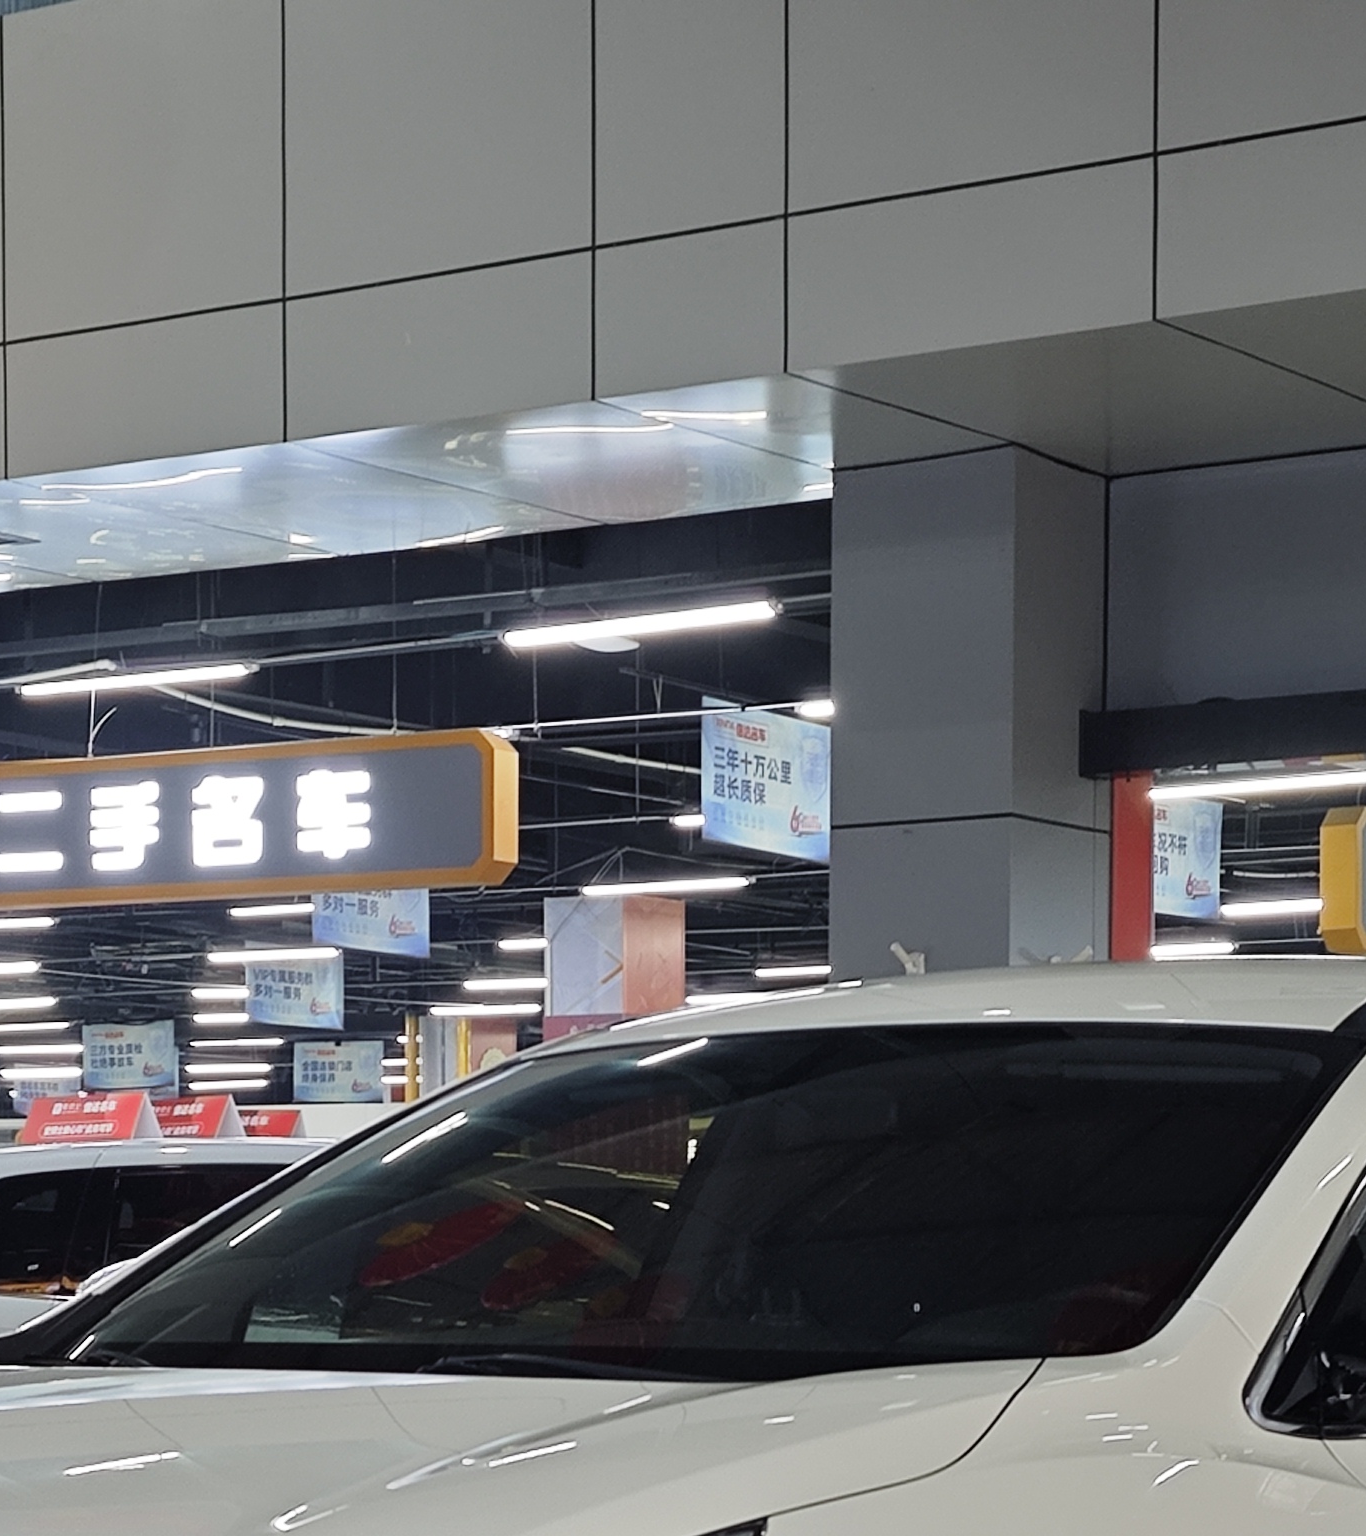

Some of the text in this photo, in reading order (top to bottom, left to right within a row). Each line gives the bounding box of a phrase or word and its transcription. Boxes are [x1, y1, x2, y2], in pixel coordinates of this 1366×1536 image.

[714, 746, 792, 785] 三年十万公里
[714, 772, 766, 806] 超长质保
[321, 891, 379, 918] 多对一服务
